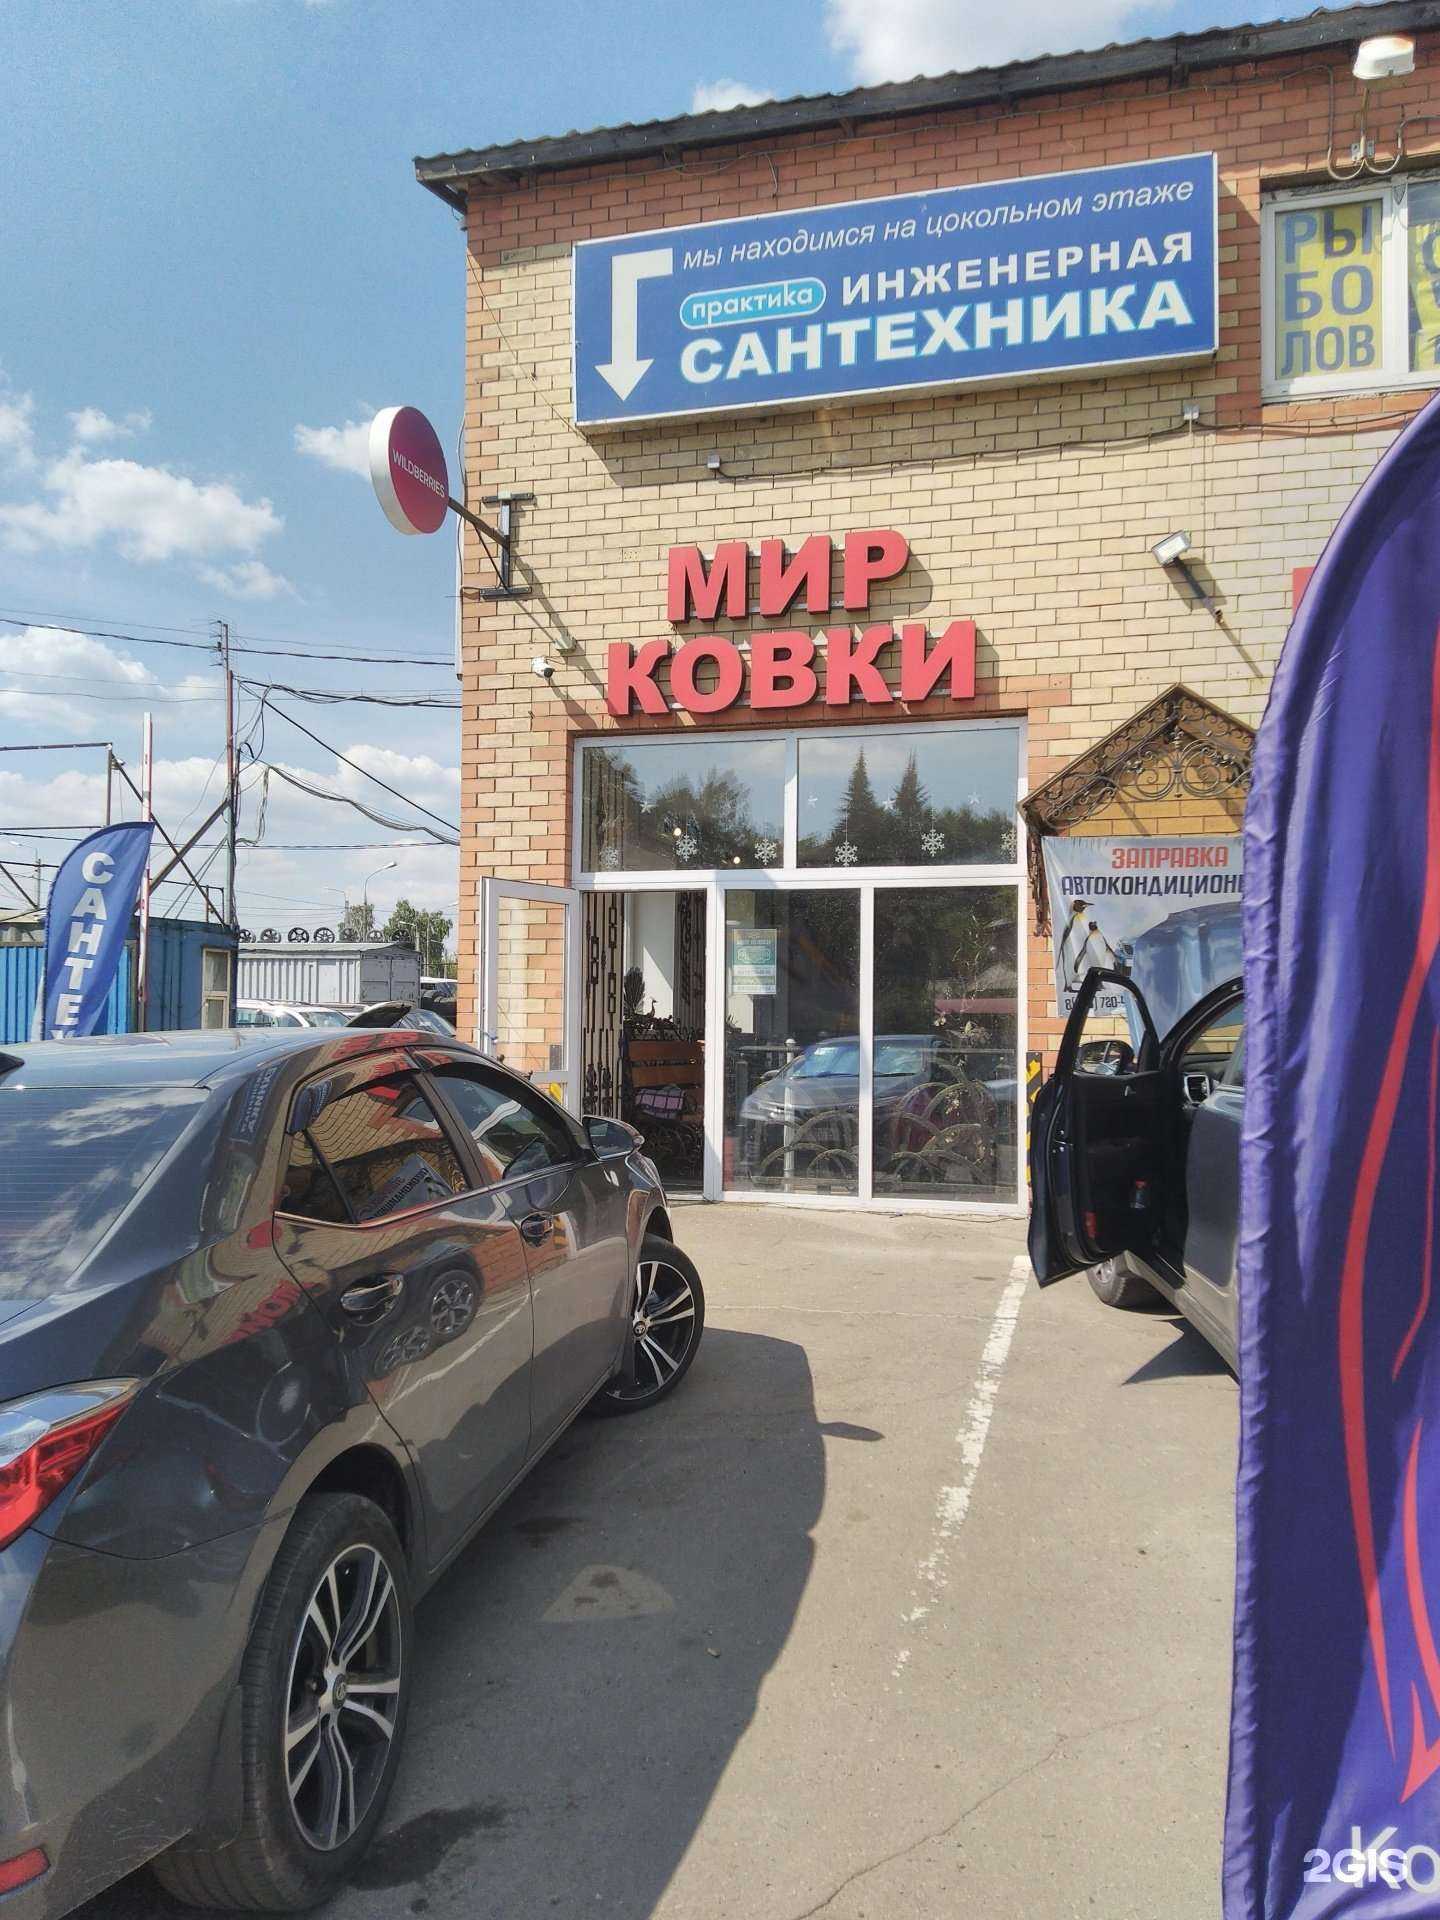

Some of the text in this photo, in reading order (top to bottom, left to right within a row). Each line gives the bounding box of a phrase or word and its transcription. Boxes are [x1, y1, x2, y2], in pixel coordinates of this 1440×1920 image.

[682, 180, 1194, 270] мы находимся на цокольном этаже
[1282, 206, 1373, 264] РЫ
[842, 231, 1193, 307] ИНЖЕНЕРНАЯ
[1283, 264, 1374, 322] БО
[680, 279, 1196, 384] САНТЕХНИКА
[691, 280, 814, 326] практика
[1281, 324, 1376, 377] ЛОВ
[392, 448, 445, 498] WILDBERRIES
[667, 529, 910, 624] МИР
[607, 619, 977, 717] КОВКИ
[1061, 874, 1244, 897] АВТОКОНДИЦИОН
[1111, 846, 1229, 869] ЗАПРАВКА
[49, 851, 116, 1039] САНТЕ
